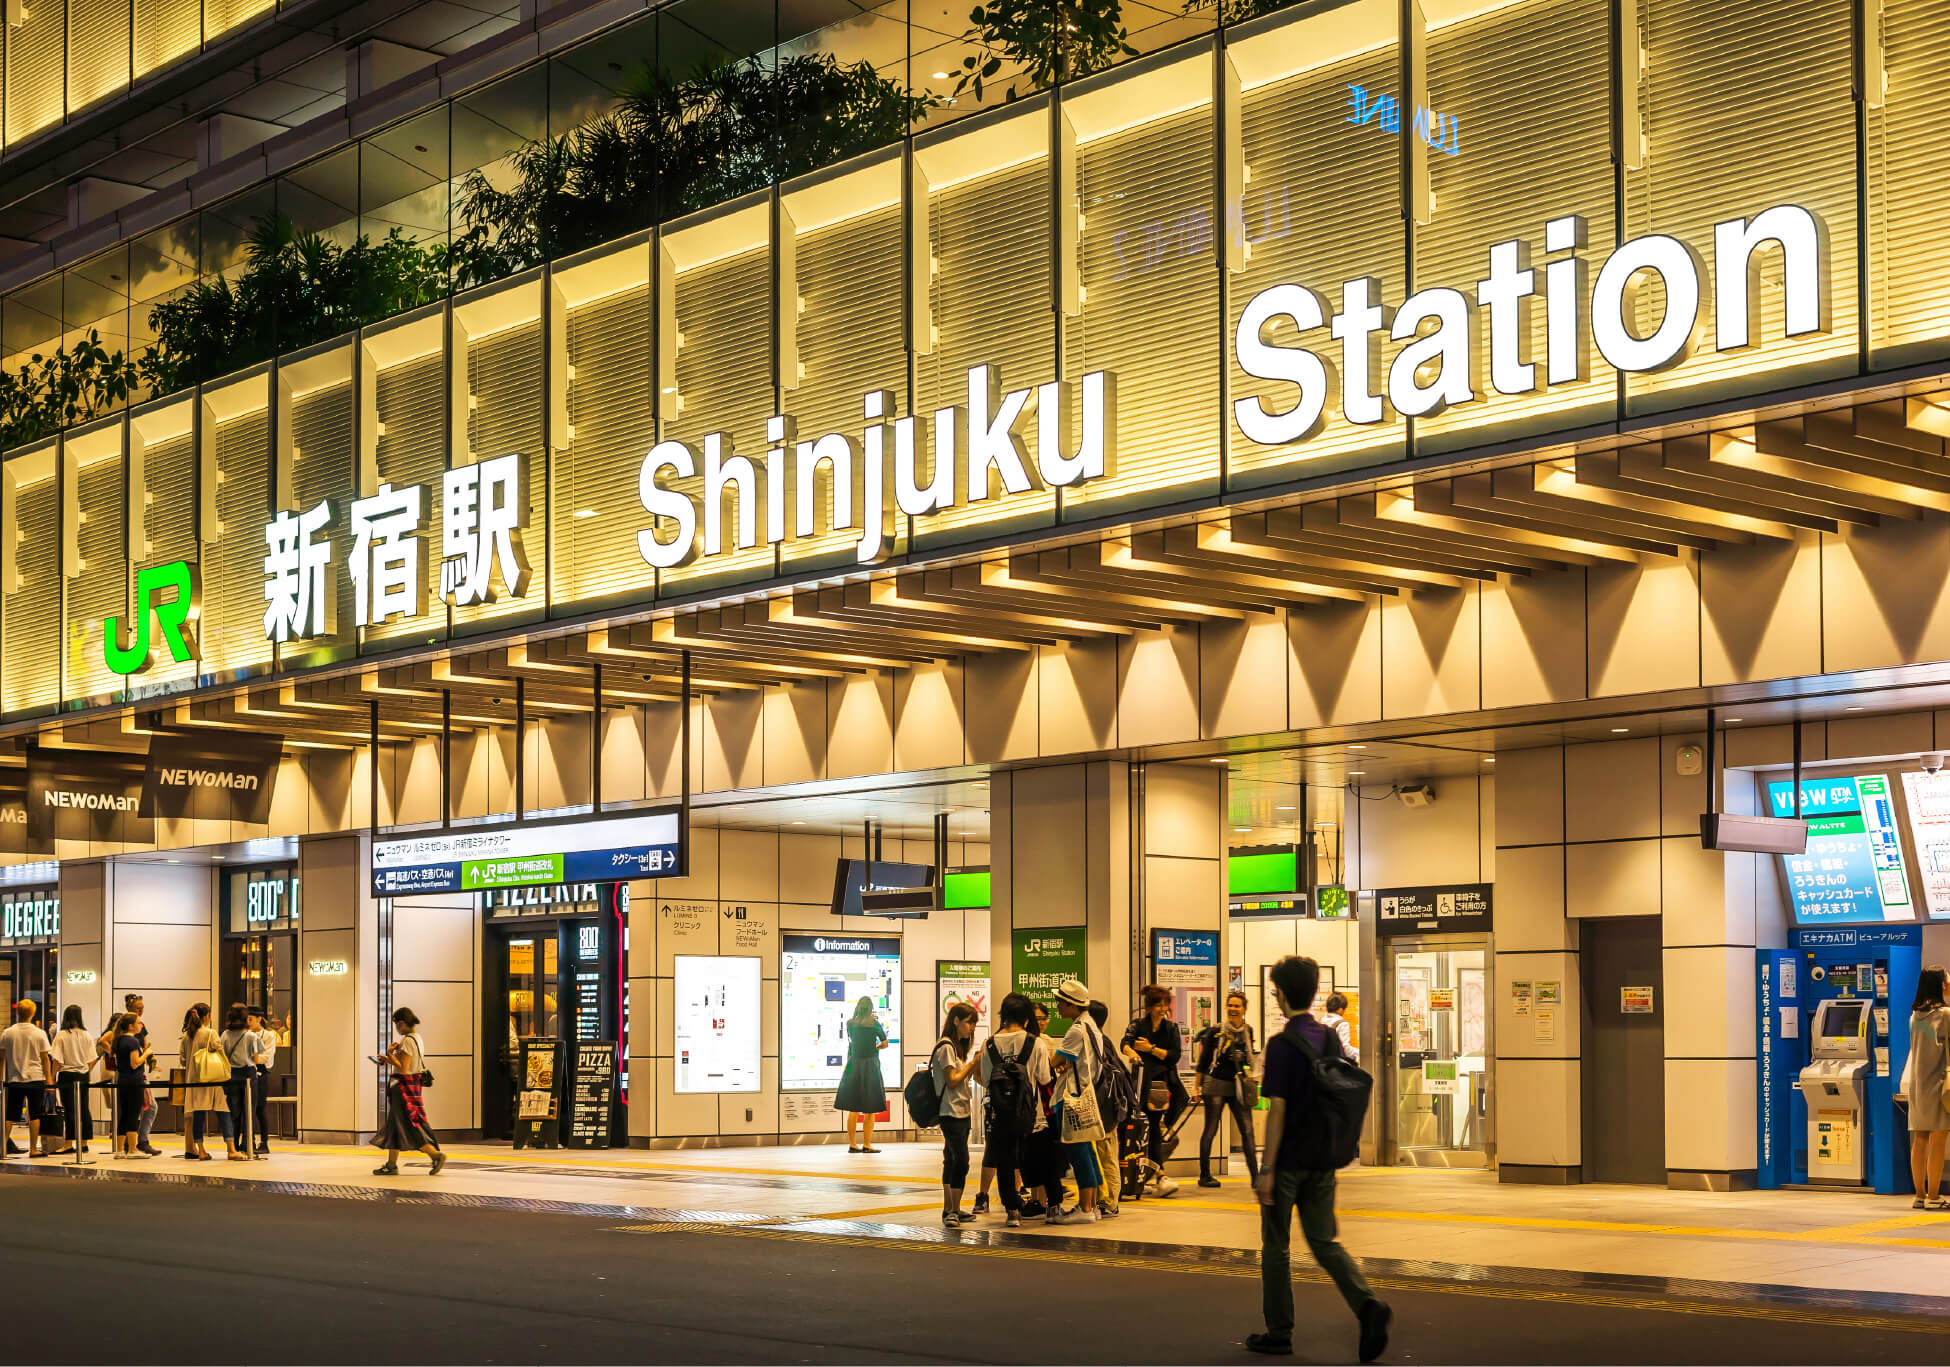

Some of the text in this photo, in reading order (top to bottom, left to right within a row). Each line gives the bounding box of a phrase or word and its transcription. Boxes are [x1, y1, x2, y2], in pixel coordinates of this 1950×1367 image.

[104, 206, 1820, 675] JR 新宿駅 Shinjuku Station
[160, 768, 258, 790] NEWoMan
[44, 790, 139, 811] NEWoMan
[482, 864, 496, 878] JR
[1793, 874, 1846, 887] ろうきんの
[1797, 887, 1873, 901] キャッシュカード
[5, 900, 59, 938] DEGREE
[674, 921, 701, 929] クリニック
[579, 927, 599, 948] 800
[1802, 931, 1908, 943] エキナカATM ビューアルッテ
[825, 940, 870, 951] Information
[1025, 939, 1040, 952] JR
[578, 1053, 611, 1067] PIZZA
